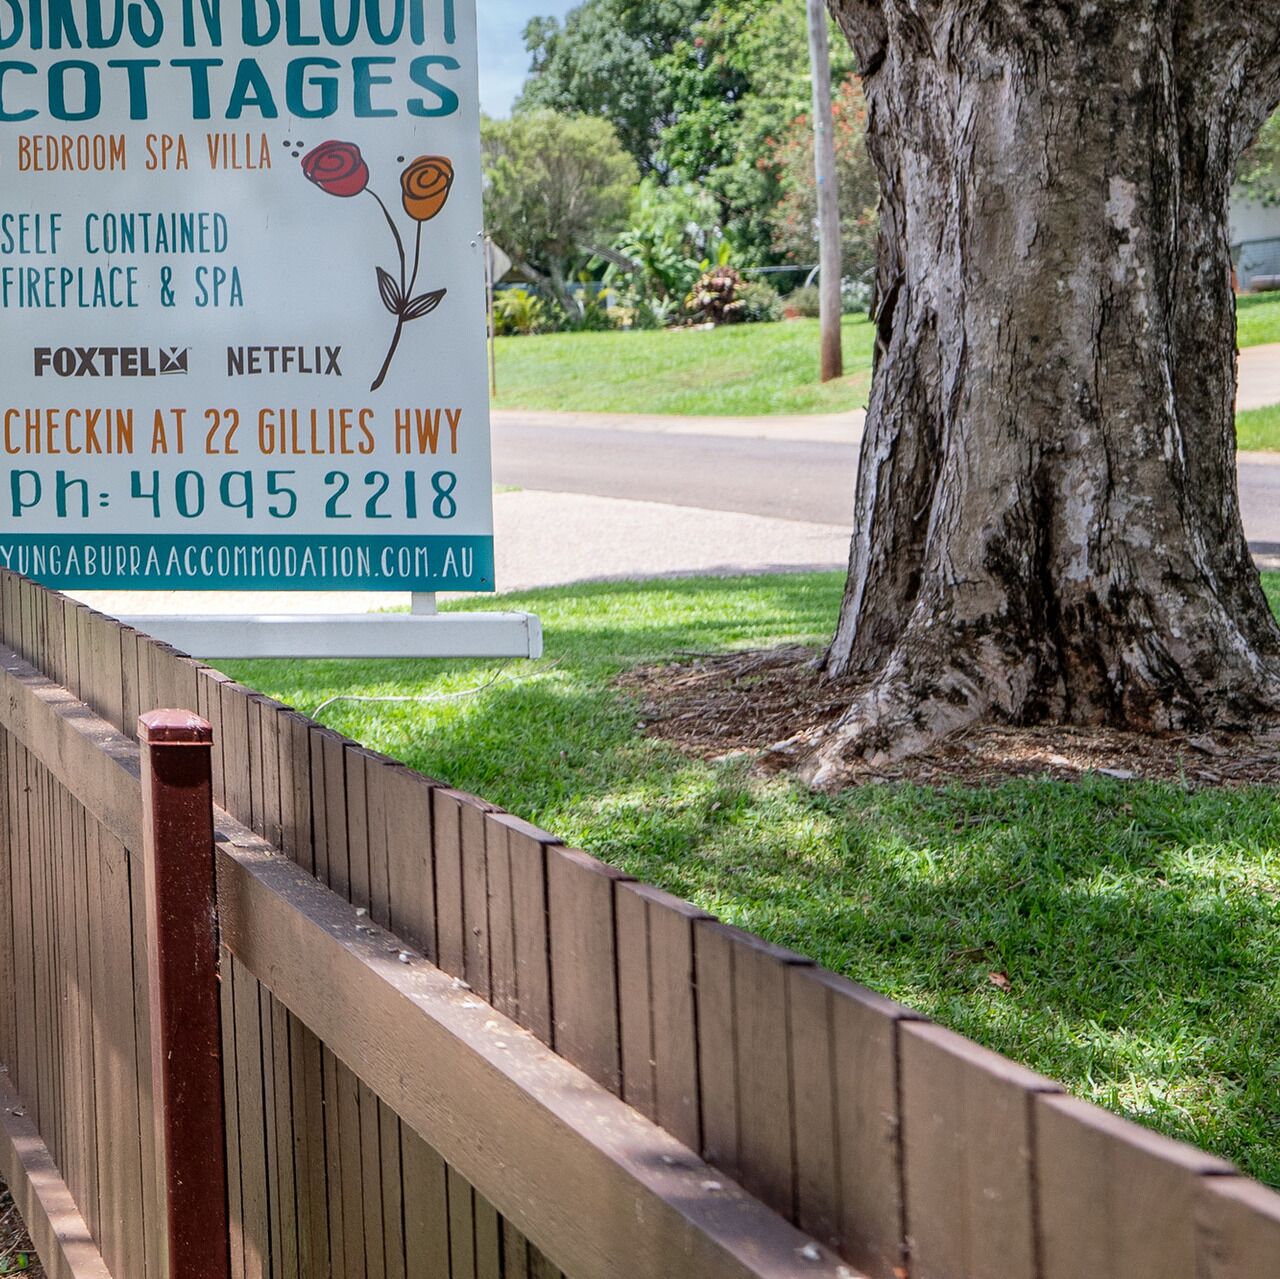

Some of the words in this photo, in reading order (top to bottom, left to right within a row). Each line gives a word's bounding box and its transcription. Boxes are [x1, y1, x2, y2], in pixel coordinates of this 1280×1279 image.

[18, 134, 126, 172] BEDROOM
[146, 133, 188, 171] SPA
[207, 132, 272, 170] VILLA
[1, 213, 62, 255] SELF
[85, 212, 228, 255] CONTAINED
[2, 266, 139, 308] FIREPLACE
[160, 266, 175, 308] &
[195, 266, 244, 308] SPA
[34, 347, 157, 377] FOXTEL
[227, 345, 343, 377] NETFLIX
[4, 408, 134, 455] CHECKIN
[151, 408, 187, 455] AT
[204, 408, 240, 455] 22
[258, 408, 375, 455] GILLIES
[395, 408, 462, 455] HWY
[130, 470, 298, 519] 4095
[324, 470, 457, 519] 2218
[0, 545, 474, 578] YUNGABURRAACCOMMODATION.COM.AU
